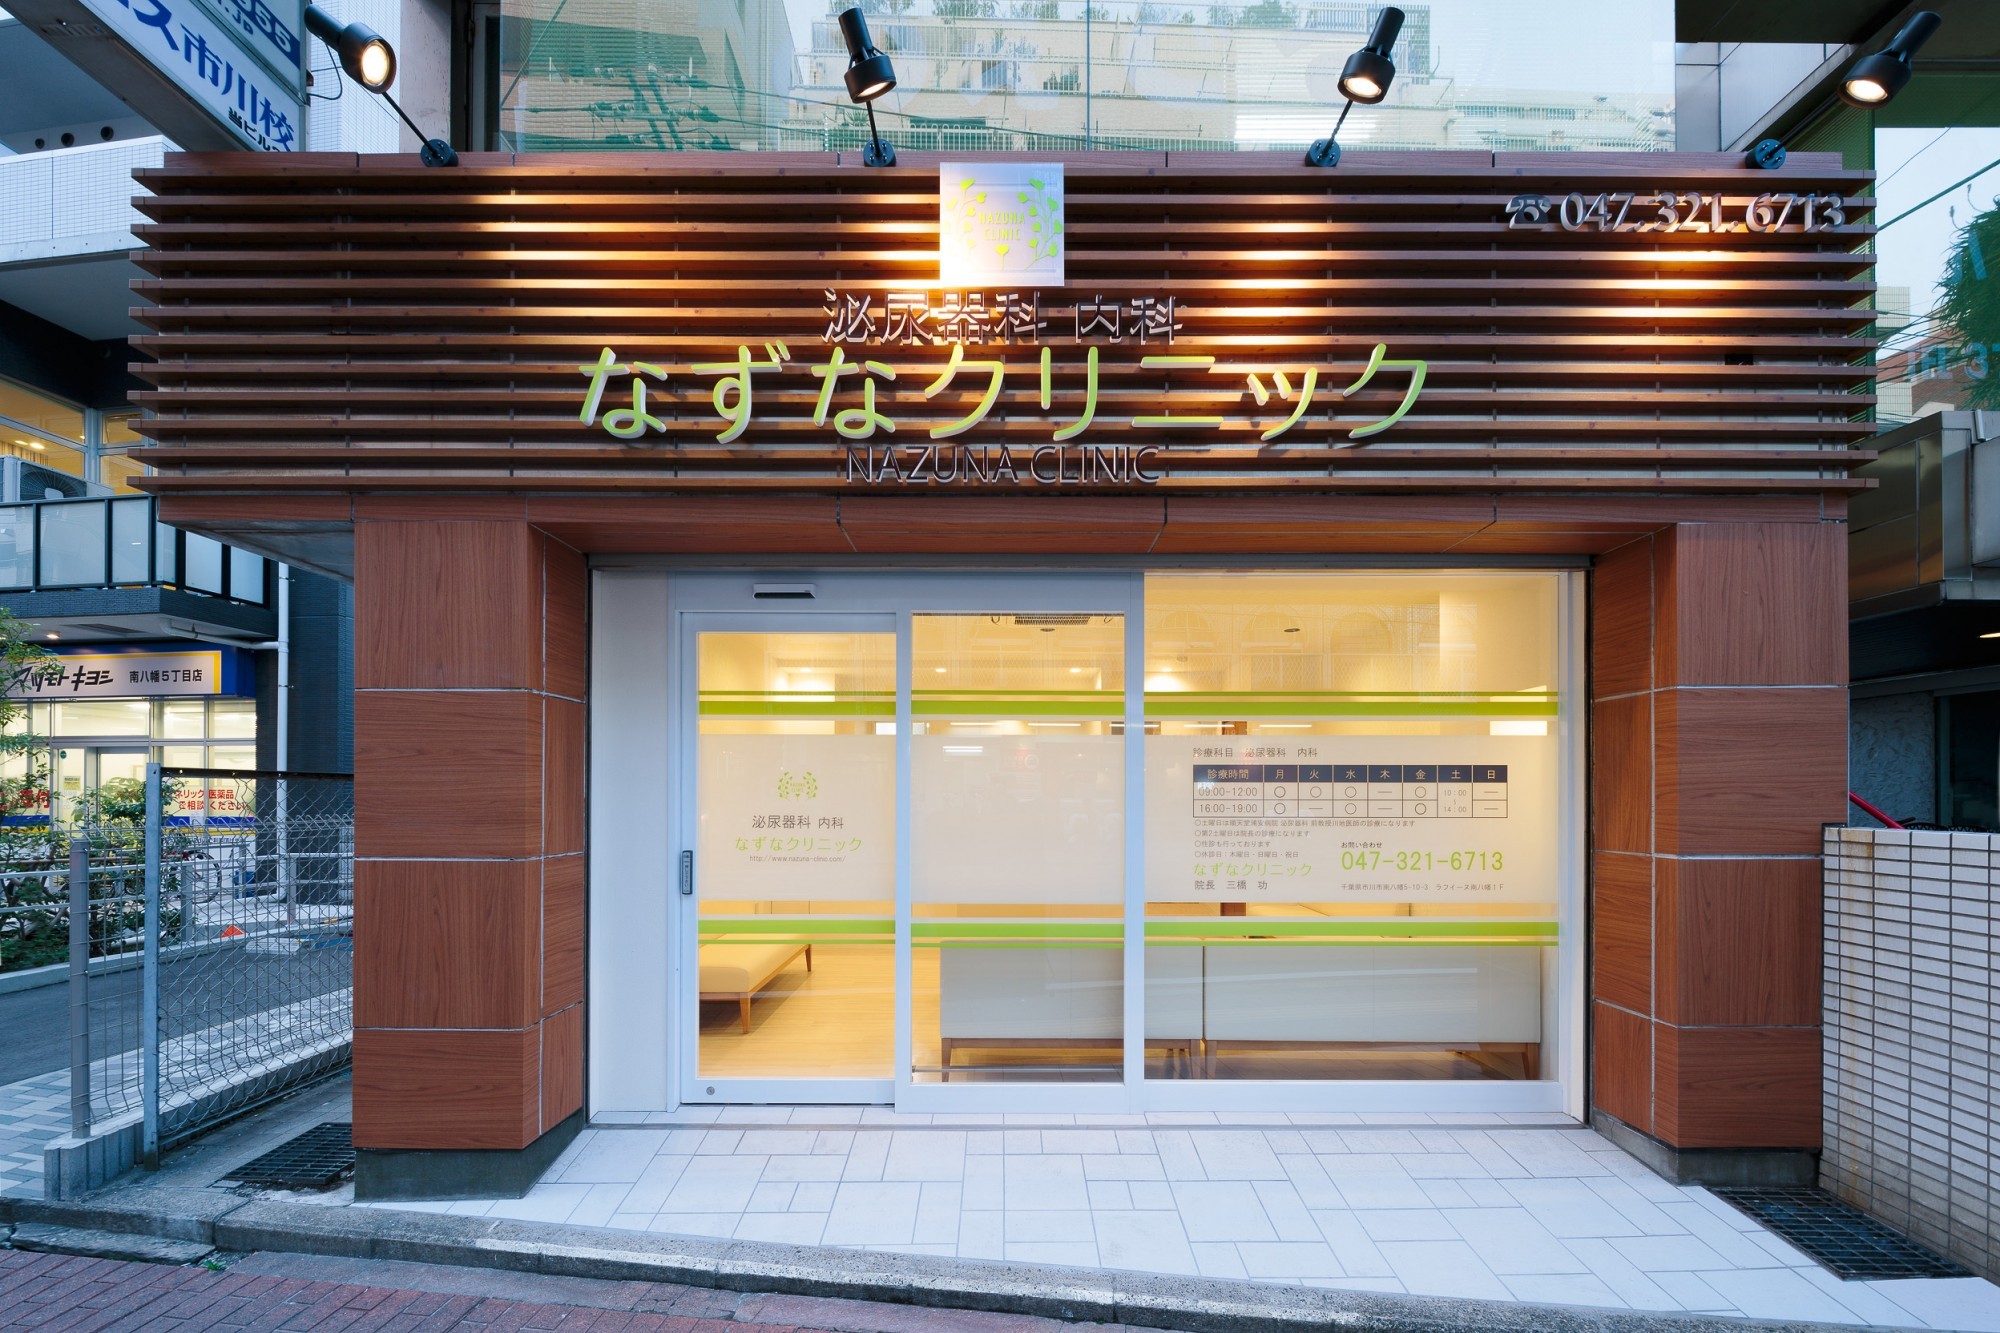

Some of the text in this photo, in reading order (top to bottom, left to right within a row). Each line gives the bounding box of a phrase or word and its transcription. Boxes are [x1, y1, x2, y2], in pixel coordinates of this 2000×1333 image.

[117, 0, 294, 151] ス市川校
[978, 211, 1026, 225] NAZUNA
[1559, 191, 1846, 233] 047.321.6713
[983, 227, 1022, 241] CLINIC
[822, 288, 1183, 347] 泌尿器科 内科
[577, 341, 1429, 444] なずなクリニック
[845, 444, 1160, 486] NAZUNA CLINIC
[129, 668, 202, 683] 南八幡5丁目店
[1193, 747, 1318, 758] 診療科目 泌尿器科 内科
[1207, 768, 1496, 780] 診療時間 月 火 水 木 金 土 日
[1199, 803, 1258, 813] 16:00-19:00
[751, 815, 844, 830] 泌尿器科 内科
[735, 836, 863, 852] なずなクリニック
[1341, 841, 1382, 849] お問い合わせ
[749, 855, 847, 863] http://www.nazuna-clinic.com/
[1341, 851, 1503, 871] 047-321-6713
[1193, 862, 1312, 877] なずなクリニック
[1194, 880, 1268, 891] 院長 三橋 功
